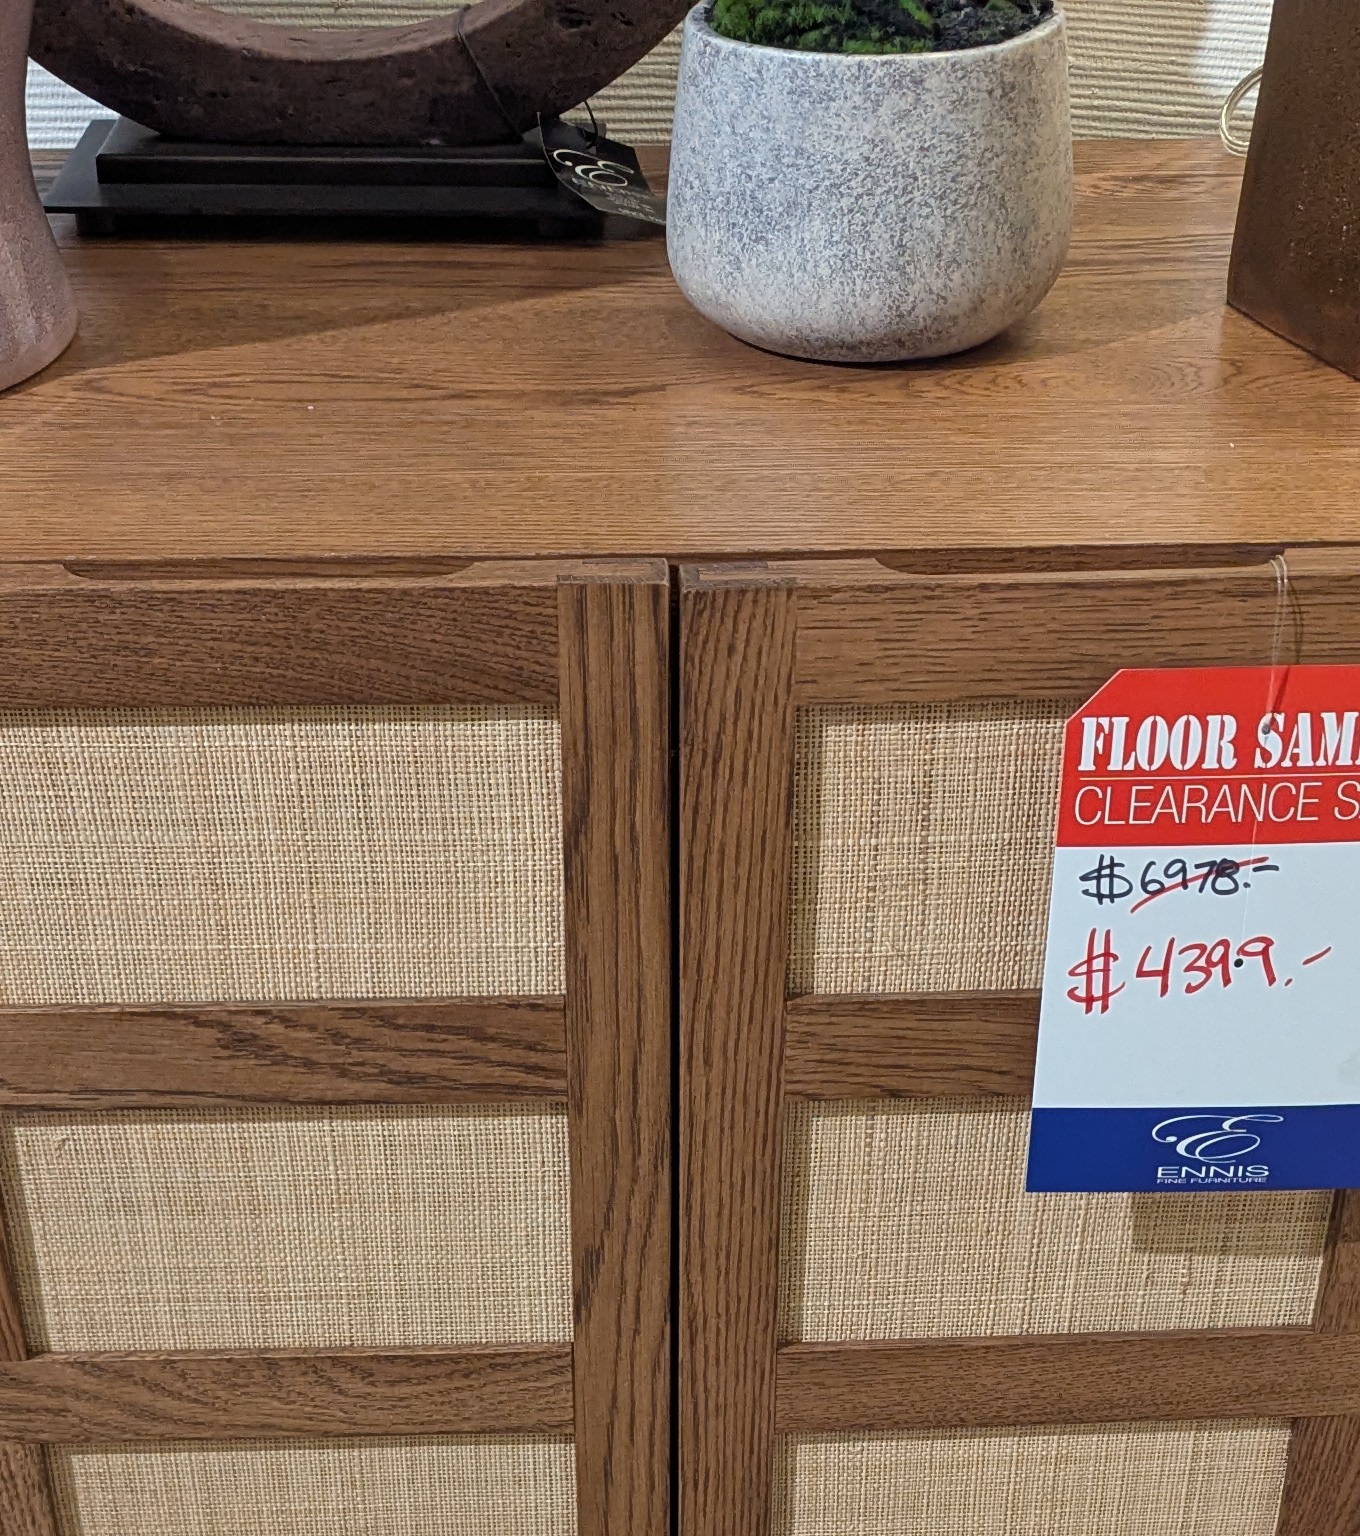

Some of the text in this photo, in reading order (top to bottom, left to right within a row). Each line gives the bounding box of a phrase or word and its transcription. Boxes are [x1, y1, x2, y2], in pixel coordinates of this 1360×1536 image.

[1078, 713, 1238, 772] FLOOR
[1074, 781, 1322, 825] CLEARANCE
[1157, 1165, 1269, 1178] ENNIS
